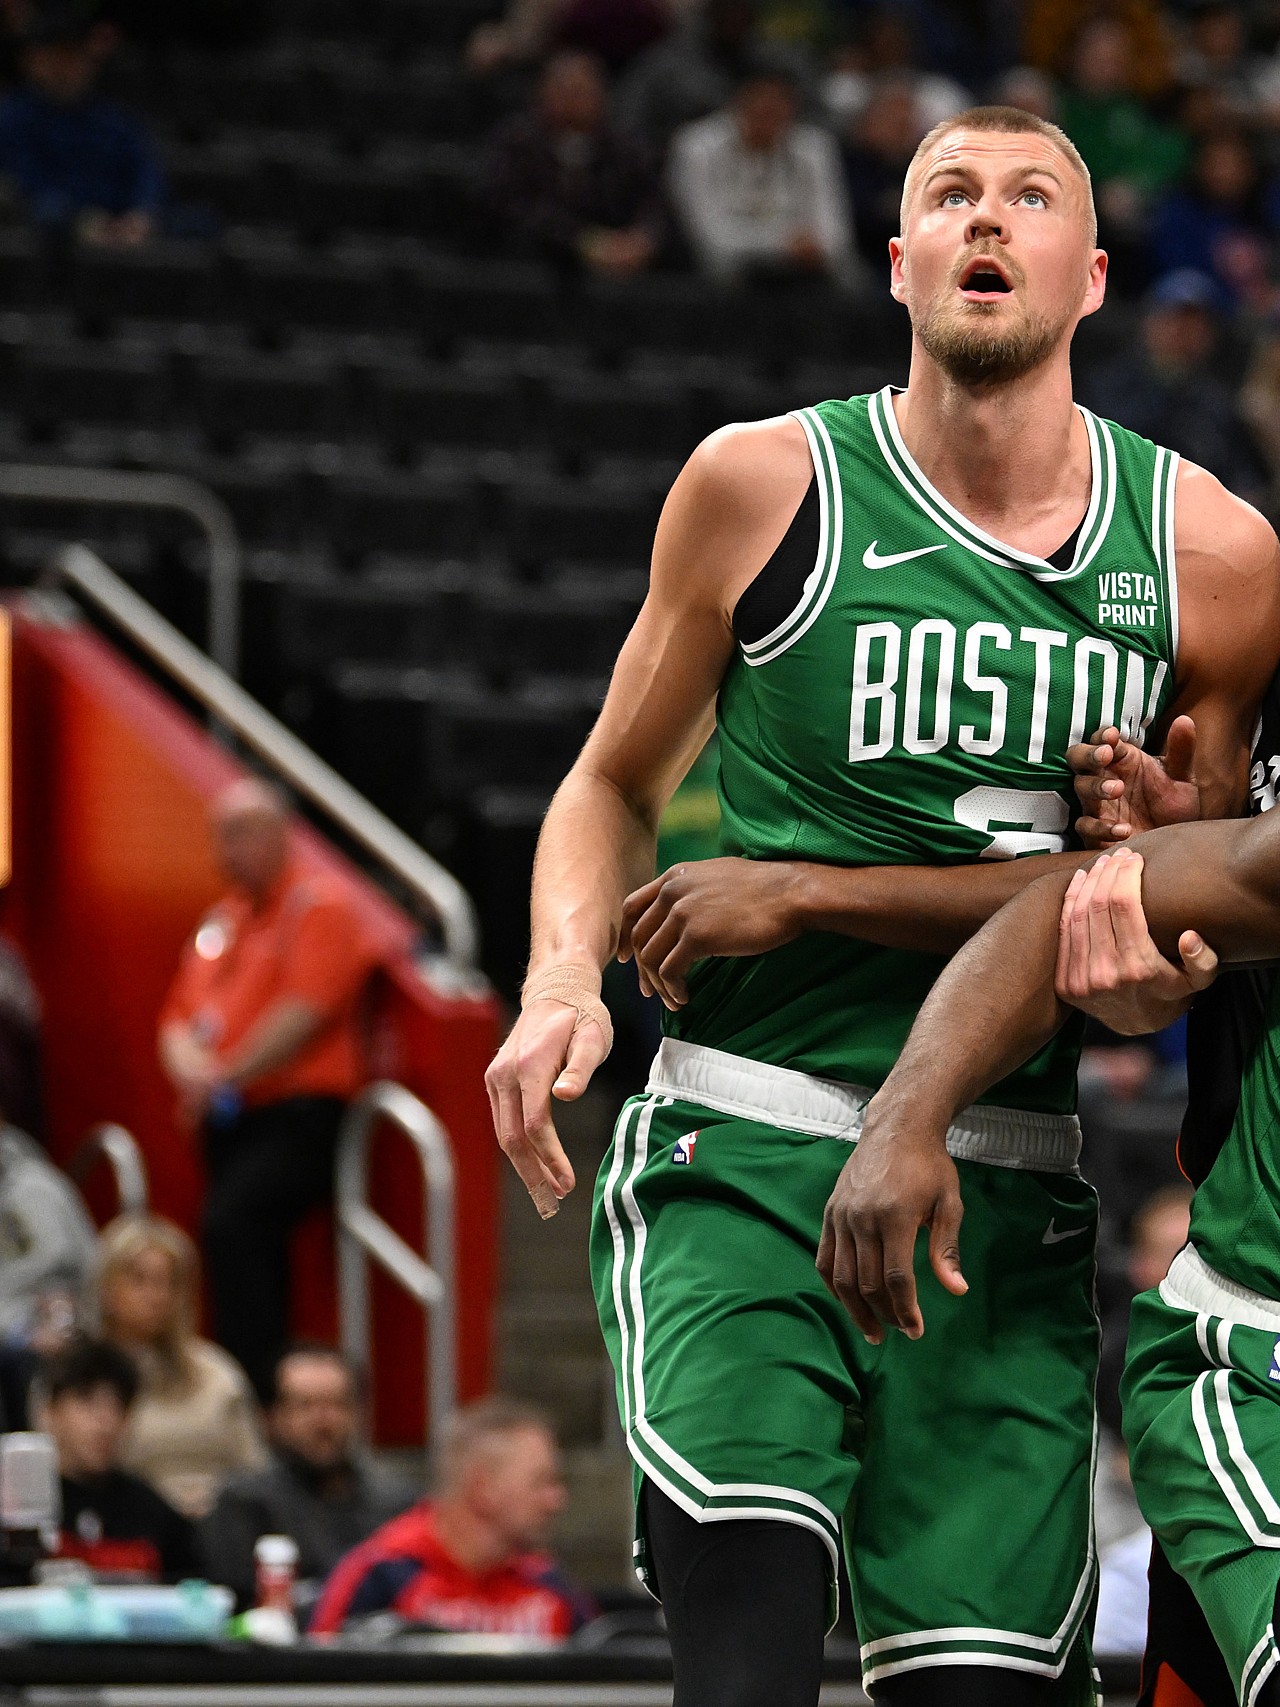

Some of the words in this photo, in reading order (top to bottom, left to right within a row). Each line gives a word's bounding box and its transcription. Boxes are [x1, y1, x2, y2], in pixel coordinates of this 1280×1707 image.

[1098, 571, 1158, 604] VISTA
[1098, 603, 1158, 626] PRINT
[848, 618, 1168, 763] BOSTON
[673, 1152, 685, 1162] NBA
